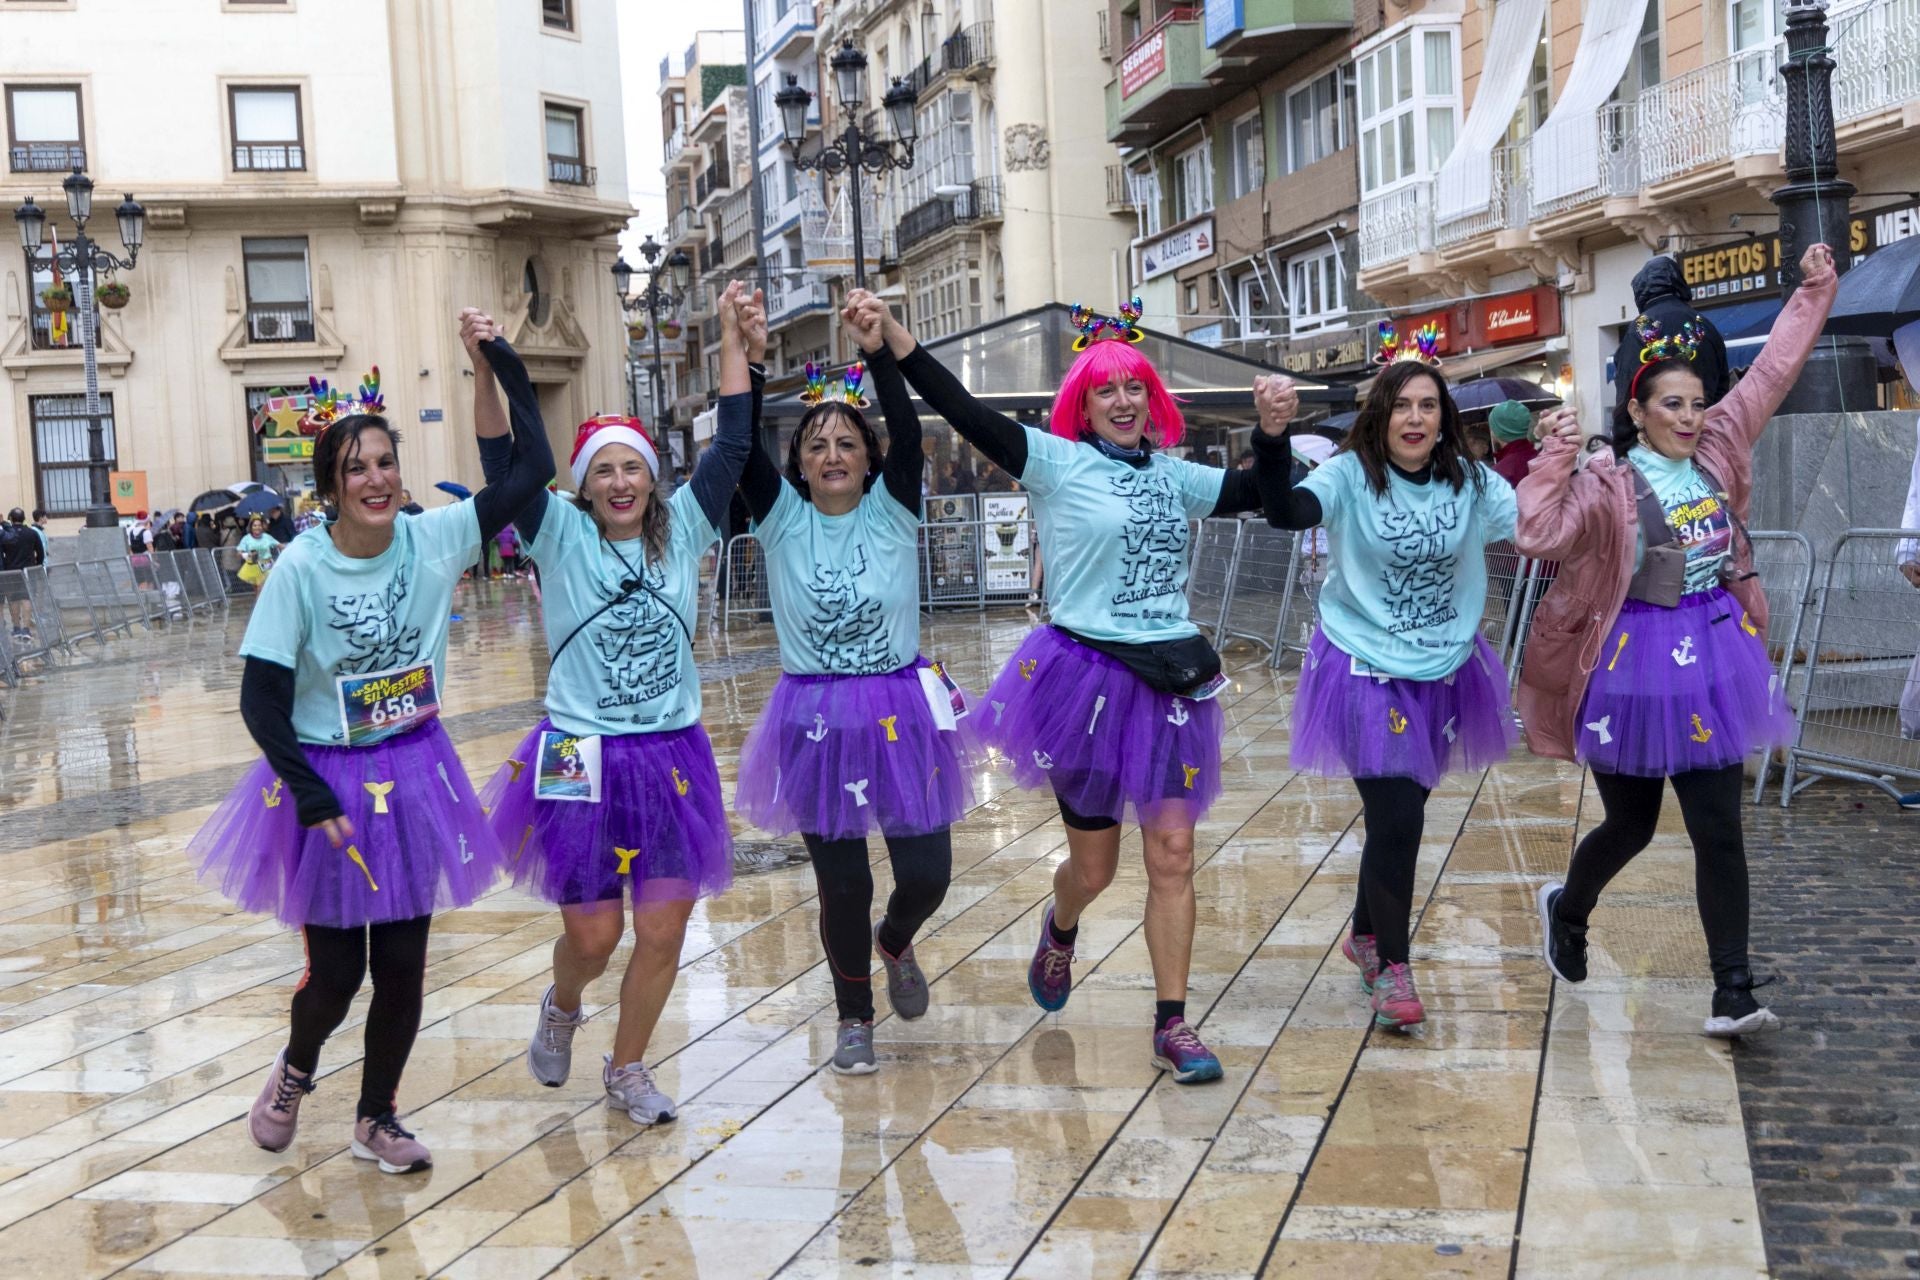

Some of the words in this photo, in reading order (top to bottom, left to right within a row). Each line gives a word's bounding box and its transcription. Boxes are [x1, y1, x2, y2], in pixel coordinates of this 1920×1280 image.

[1122, 32, 1162, 77] SEGUROS
[1683, 242, 1767, 284] EFECTOS
[1283, 351, 1311, 372] YELLOW
[1316, 340, 1365, 369] SUARINE
[1110, 472, 1175, 498] SAN
[1379, 501, 1458, 541] SAN
[1670, 504, 1689, 520] SAN
[1118, 525, 1188, 554] VES
[1388, 535, 1453, 568] SIL
[1381, 557, 1457, 596] VES
[1383, 584, 1454, 620] TRE
[595, 621, 676, 662] VES
[802, 600, 884, 648] VES
[600, 645, 677, 689] TRE
[364, 677, 390, 694] SAN
[364, 668, 425, 705] SILVESTRE
[371, 694, 417, 724] 658
